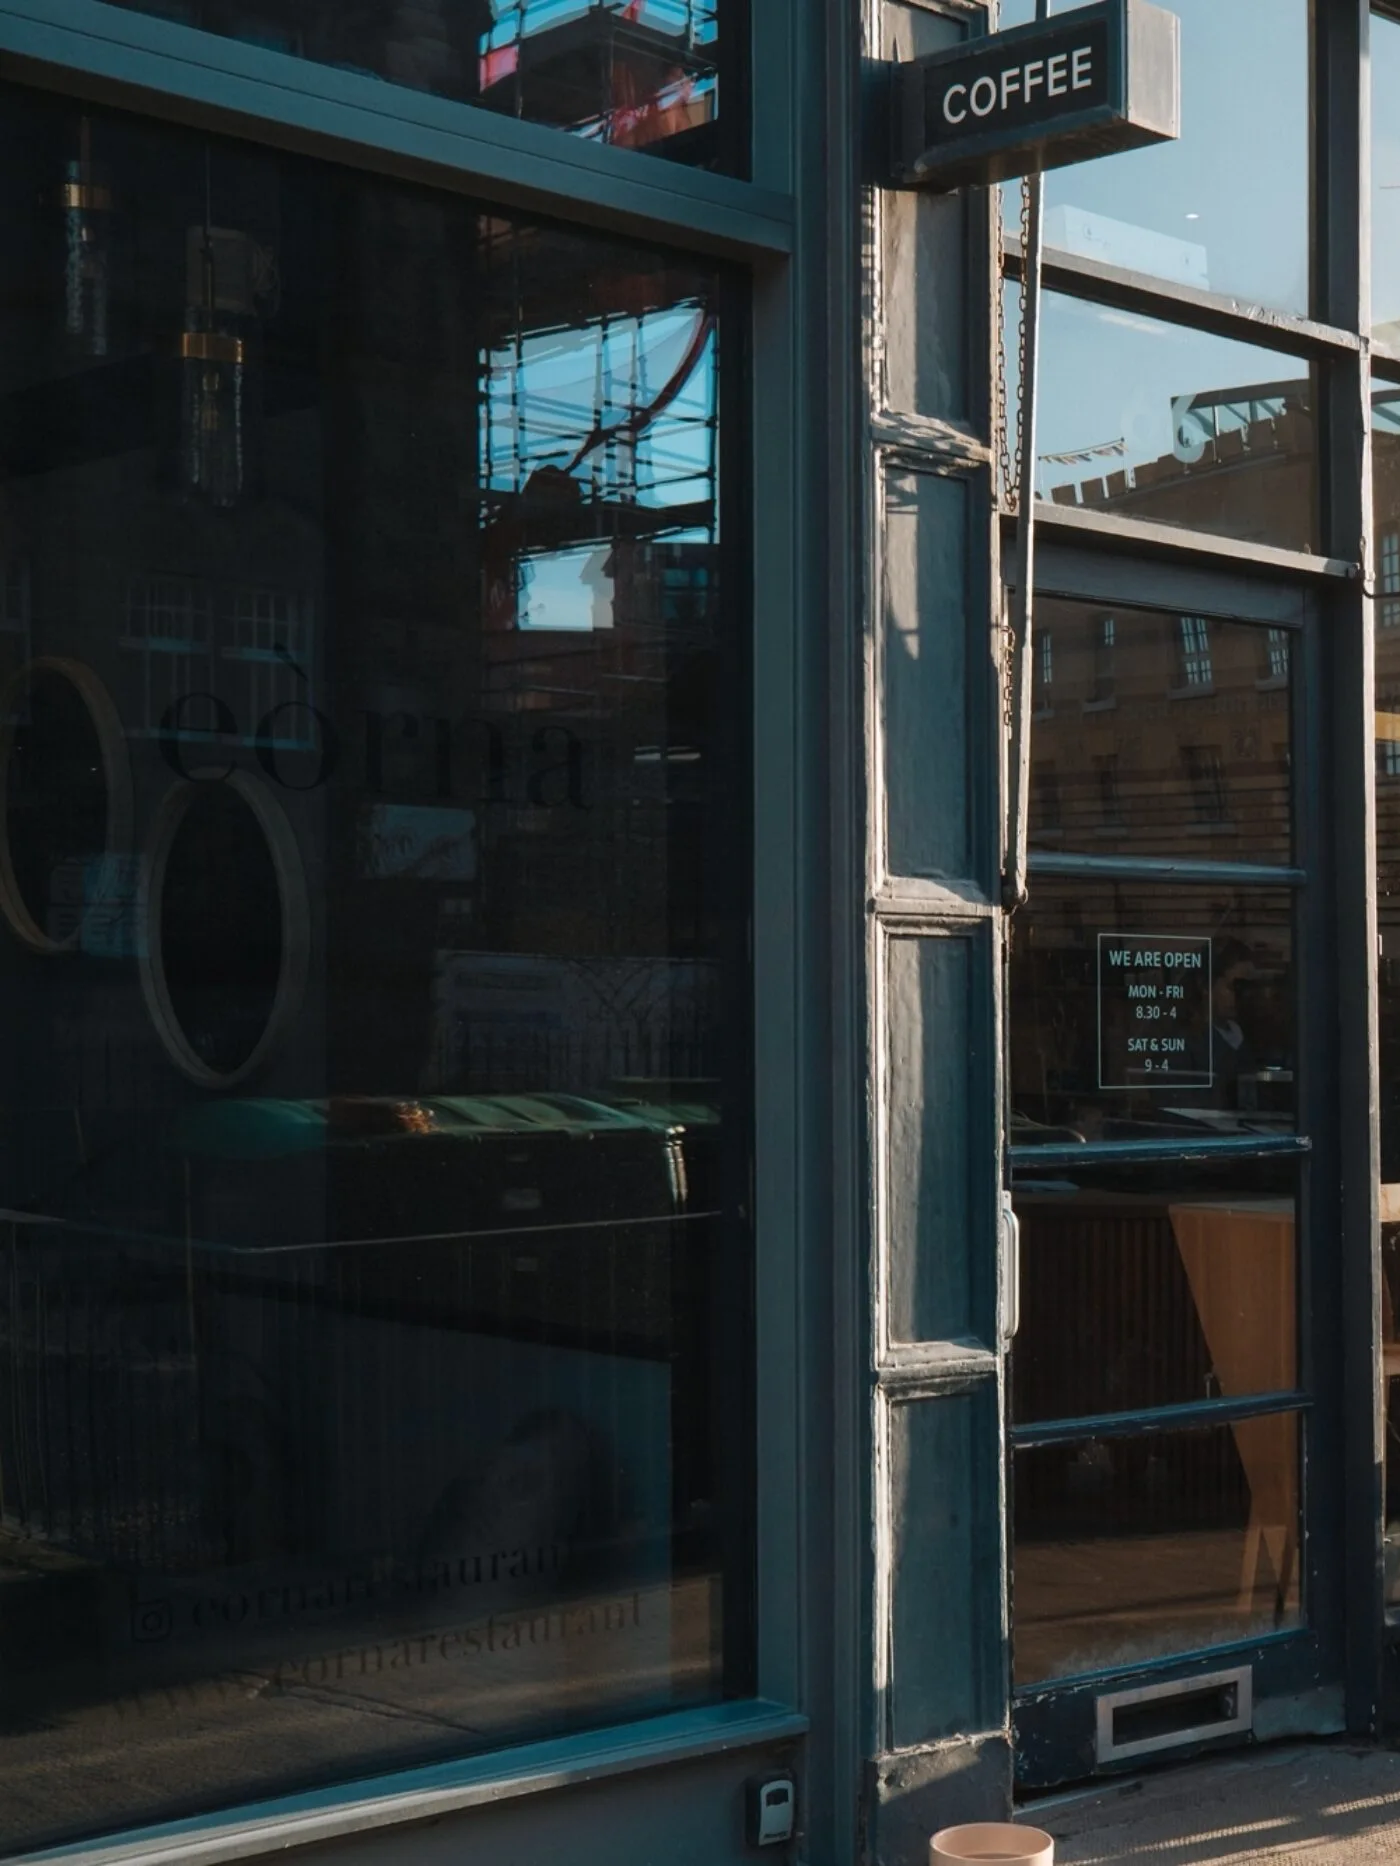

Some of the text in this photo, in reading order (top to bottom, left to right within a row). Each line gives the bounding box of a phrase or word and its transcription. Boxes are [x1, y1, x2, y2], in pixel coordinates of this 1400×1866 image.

[942, 46, 1093, 125] COFFEE
[1108, 950, 1202, 968] WE ARE OPEN
[1128, 984, 1157, 998] MON
[1165, 985, 1184, 999] FRI
[1136, 1005, 1160, 1019] 8.30
[1169, 1005, 1177, 1019] 4
[1127, 1038, 1185, 1052] SAT & SUN
[1144, 1058, 1152, 1072] 9
[1161, 1058, 1169, 1072] 4
